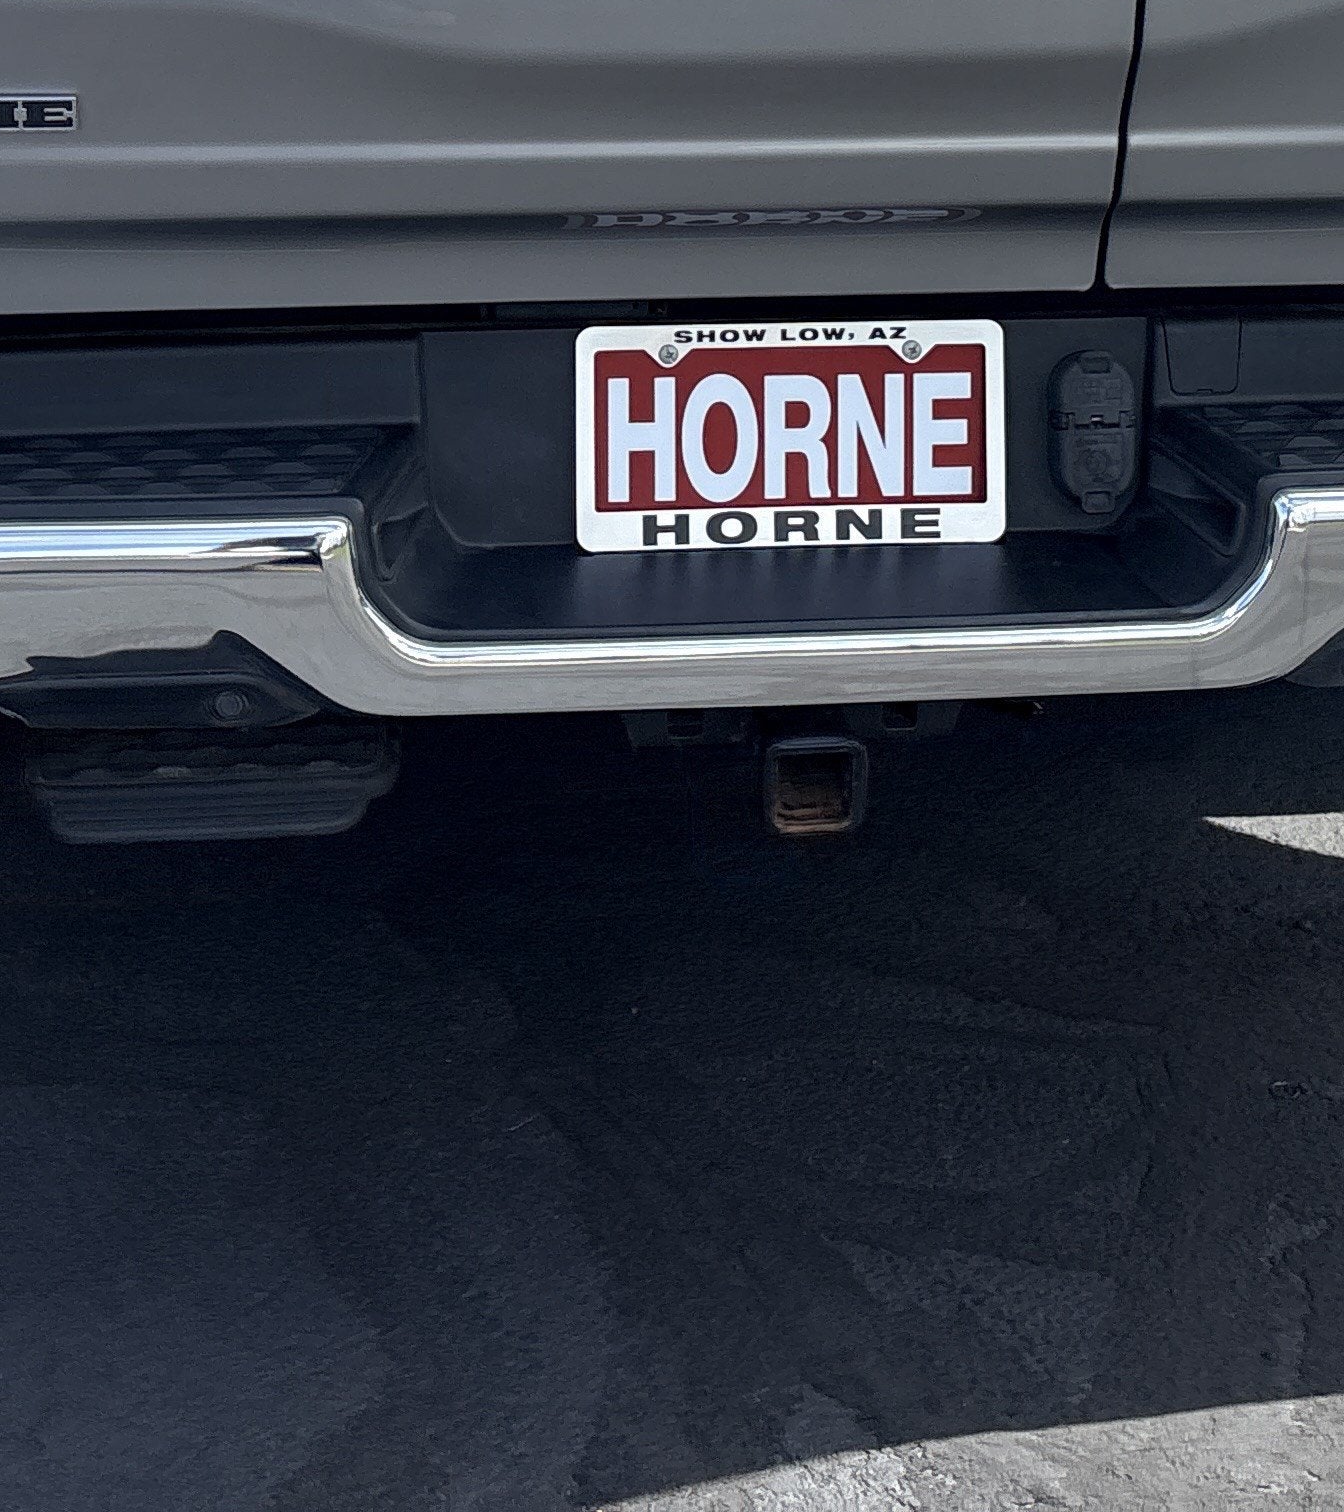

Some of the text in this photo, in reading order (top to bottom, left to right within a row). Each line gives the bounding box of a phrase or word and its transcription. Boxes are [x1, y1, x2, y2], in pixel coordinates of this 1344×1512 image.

[673, 326, 907, 344] SHOW LOW, AZ
[606, 371, 973, 503] HORNE
[642, 507, 942, 547] HORNE
